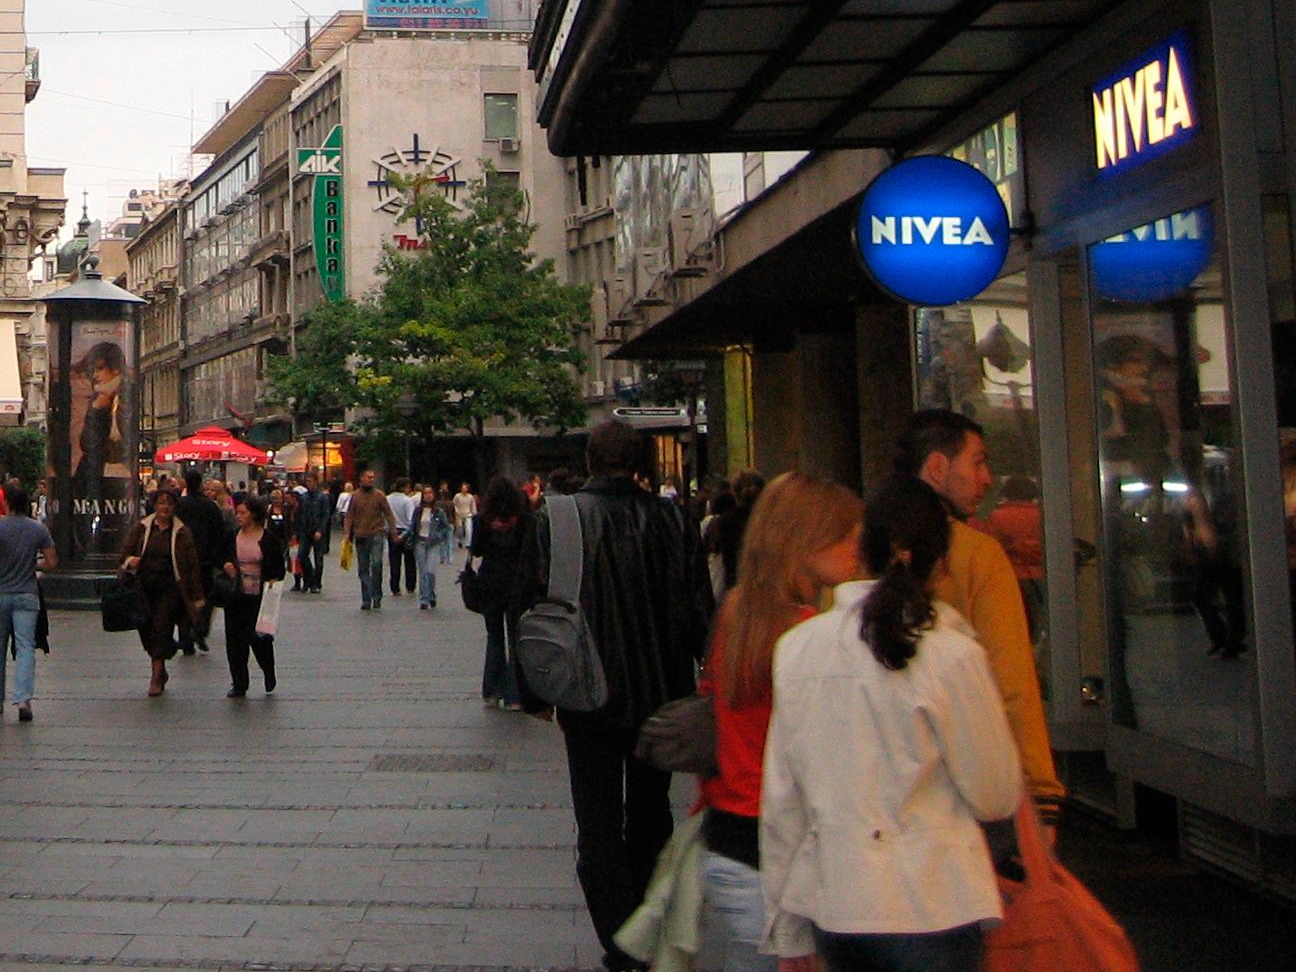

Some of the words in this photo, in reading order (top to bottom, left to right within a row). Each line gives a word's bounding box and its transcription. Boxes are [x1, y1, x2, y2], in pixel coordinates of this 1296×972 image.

[1092, 45, 1193, 170] NIVEA
[871, 215, 994, 246] NIVEA
[73, 498, 137, 515] MANGO
